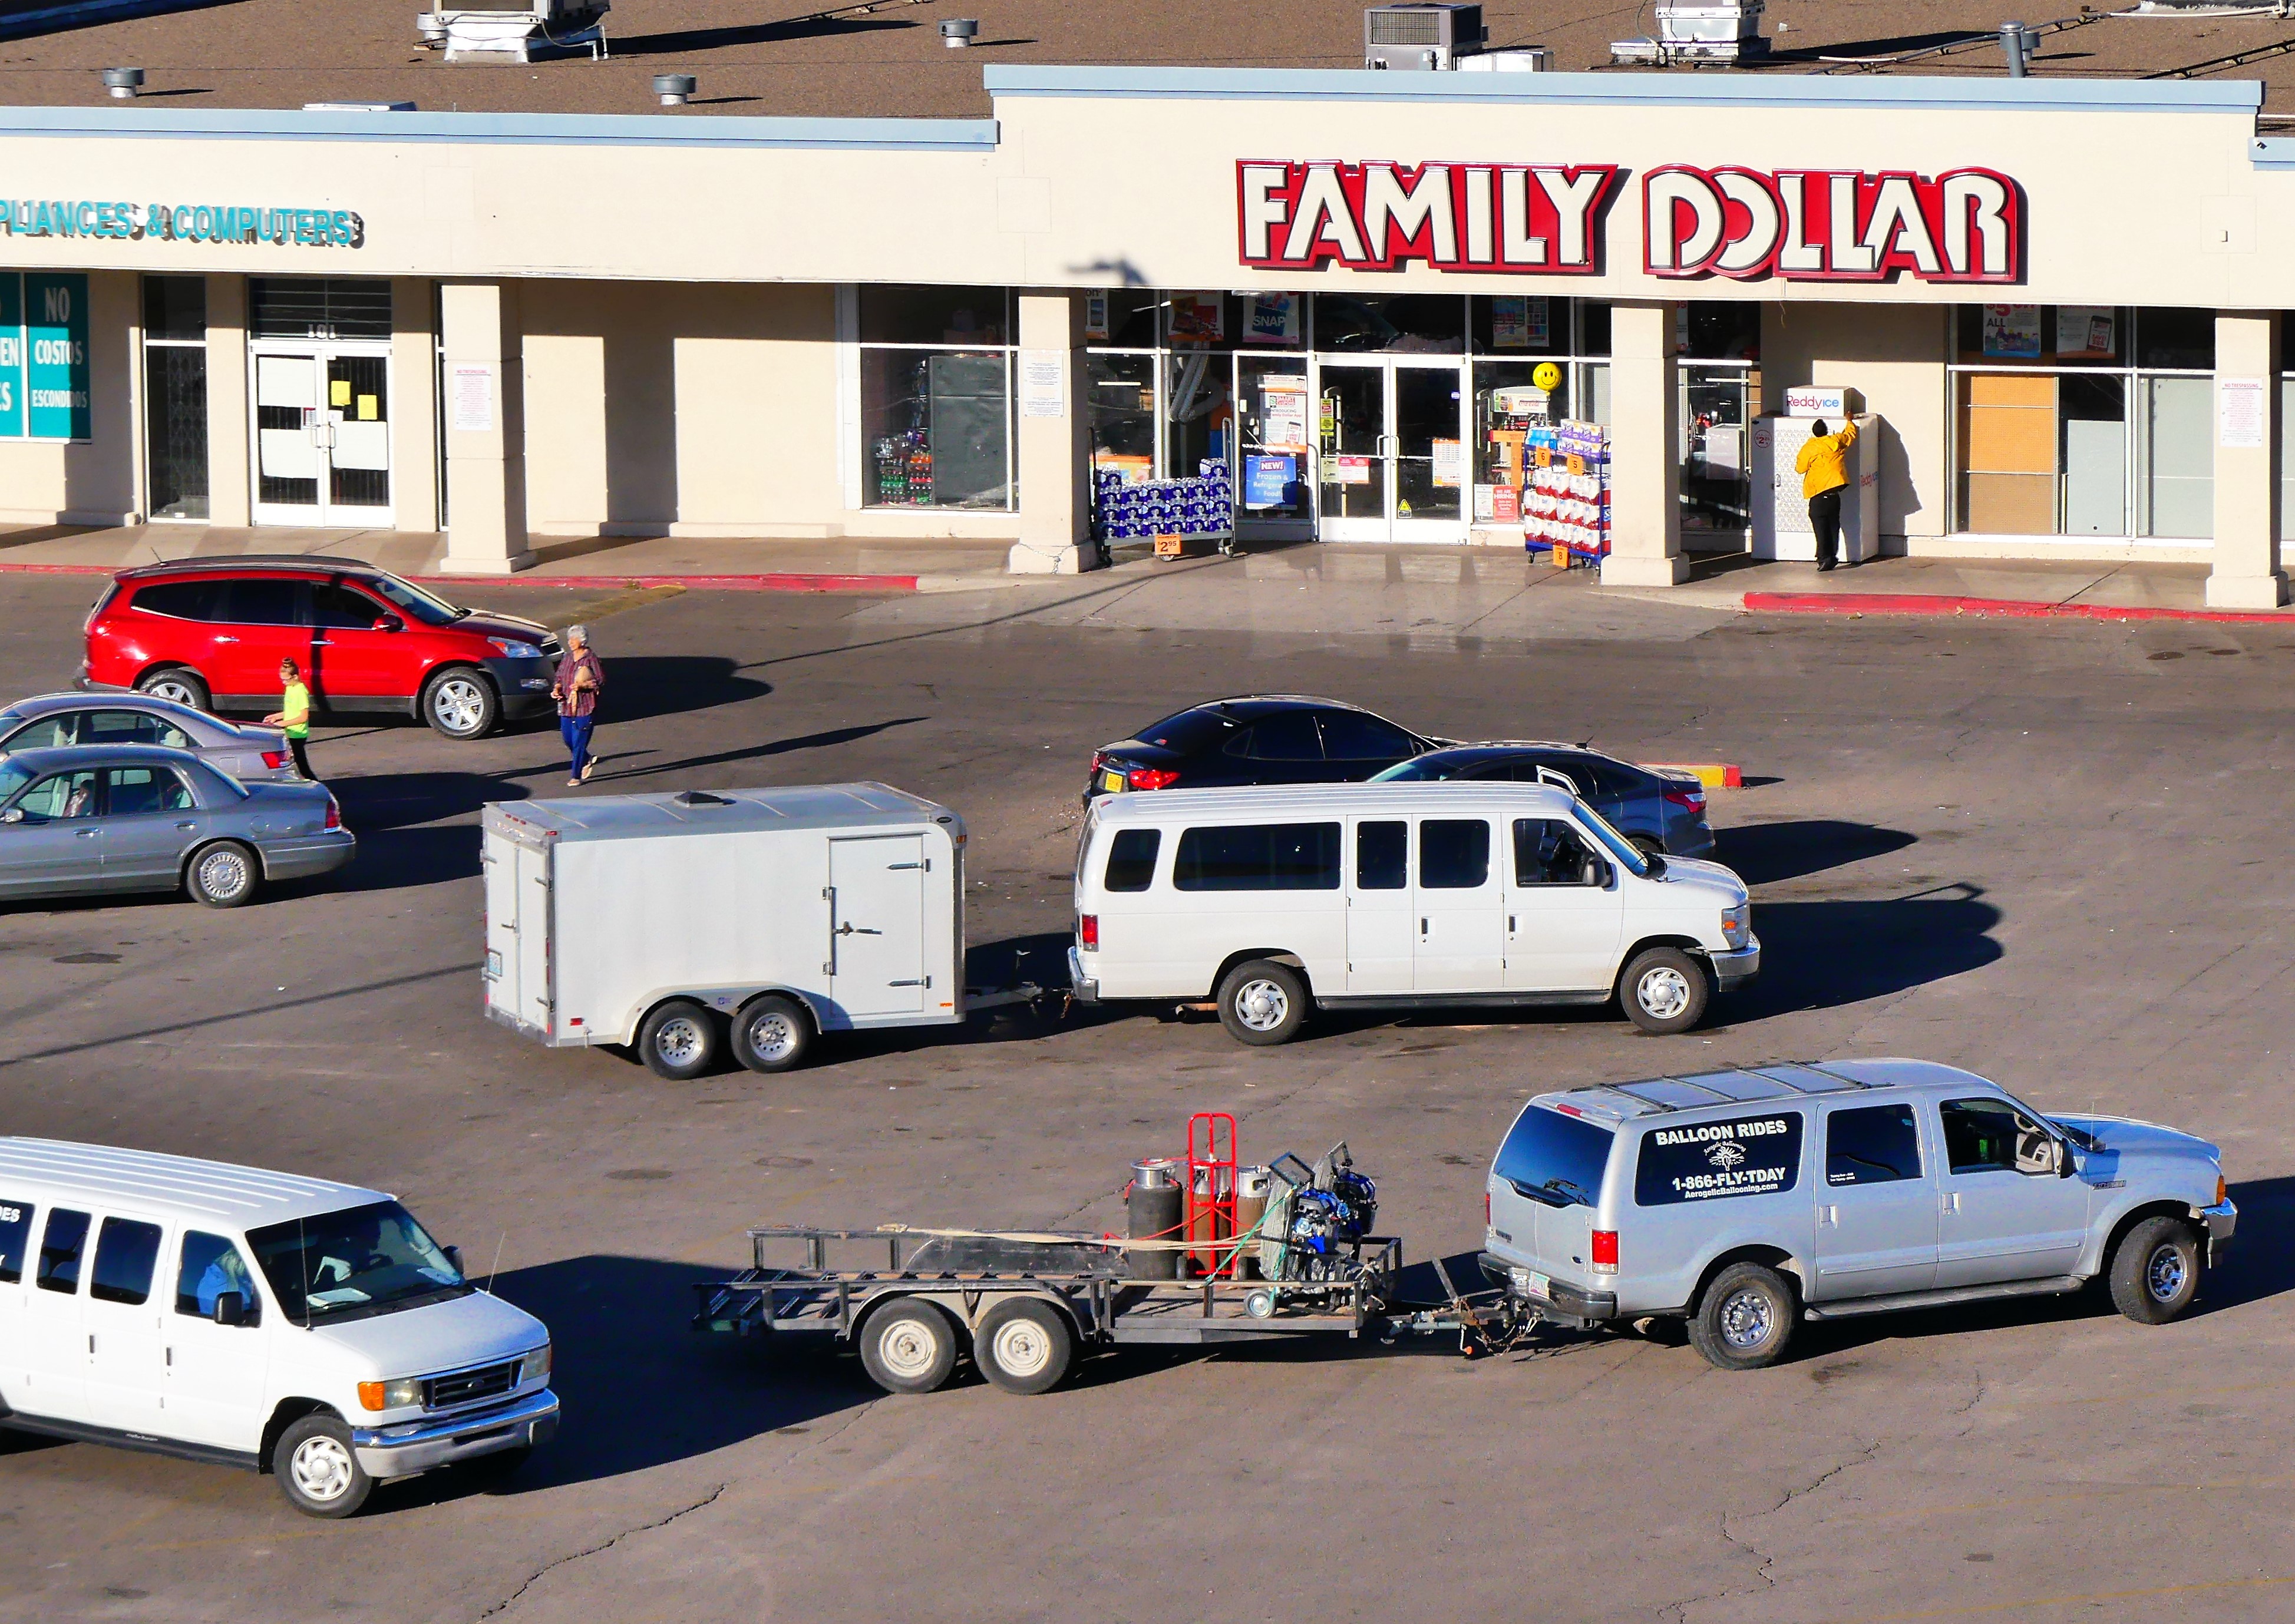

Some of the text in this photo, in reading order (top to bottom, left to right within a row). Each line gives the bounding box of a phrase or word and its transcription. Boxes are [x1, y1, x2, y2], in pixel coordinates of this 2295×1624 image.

[146, 203, 163, 237] &
[172, 204, 352, 244] COMPUTERS
[1242, 164, 2008, 273] FAMILY DOLLAR
[44, 287, 70, 322] NO
[1253, 316, 1284, 326] SNAP
[1987, 318, 2006, 327] ALL
[35, 339, 82, 365] COSTOS
[32, 389, 87, 408] ESCONDIDOS
[1541, 452, 1546, 460] 6
[1573, 460, 1578, 468] 5
[1261, 461, 1283, 471] NEW!
[1256, 472, 1282, 480] Frozen
[1558, 552, 1563, 560] 8
[1655, 1119, 1787, 1146] BALLOON RIDES
[1672, 1167, 1786, 1191] 1-866-FLY-TDAY
[0, 1205, 21, 1223] ES
